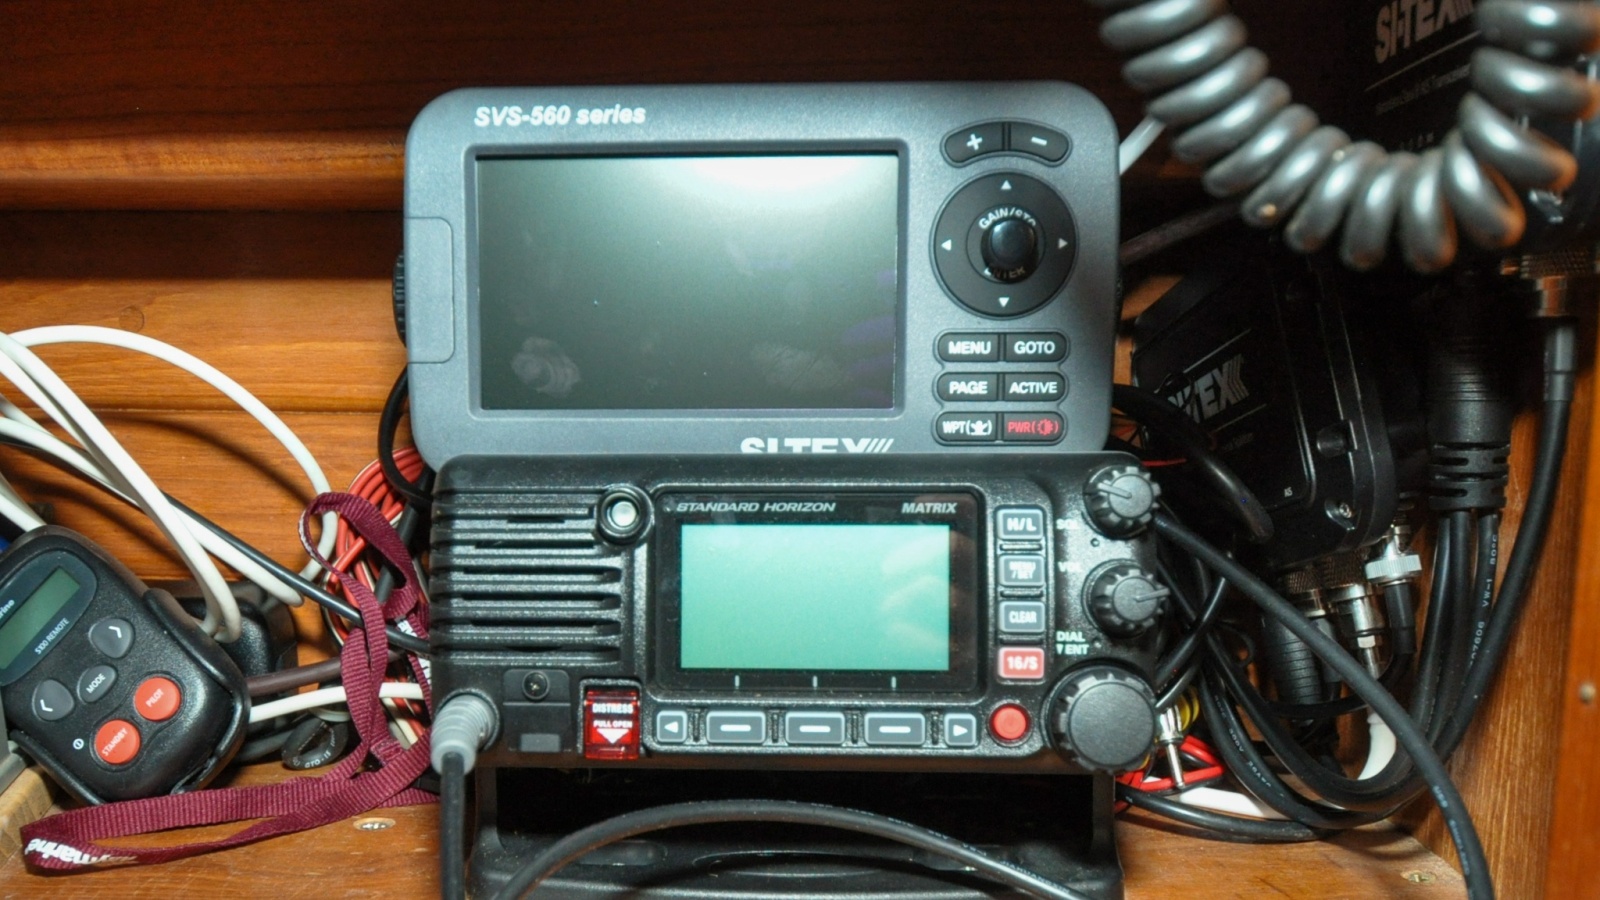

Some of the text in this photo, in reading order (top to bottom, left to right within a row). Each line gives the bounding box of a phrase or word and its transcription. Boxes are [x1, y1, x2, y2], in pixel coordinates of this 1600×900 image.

[474, 104, 646, 127] SVS-560 series
[948, 341, 991, 354] MENU
[1014, 341, 1055, 354] GOTO
[949, 381, 988, 395] PAGE
[1009, 382, 1058, 394] ACTIVE
[676, 502, 836, 512] STANDARD HORIZON
[902, 502, 957, 514] MATRIX
[1007, 518, 1037, 531] H/L
[1009, 611, 1037, 623] CLEAR
[34, 617, 70, 655] S100 REMOTE
[1056, 631, 1085, 642] DIAL
[1007, 656, 1038, 669] 16/S
[86, 673, 106, 694] MODE
[146, 688, 164, 707] PILOT
[592, 703, 633, 714] DISTRESS
[593, 720, 633, 729] PULL OPEN
[102, 728, 128, 756] STANDBY
